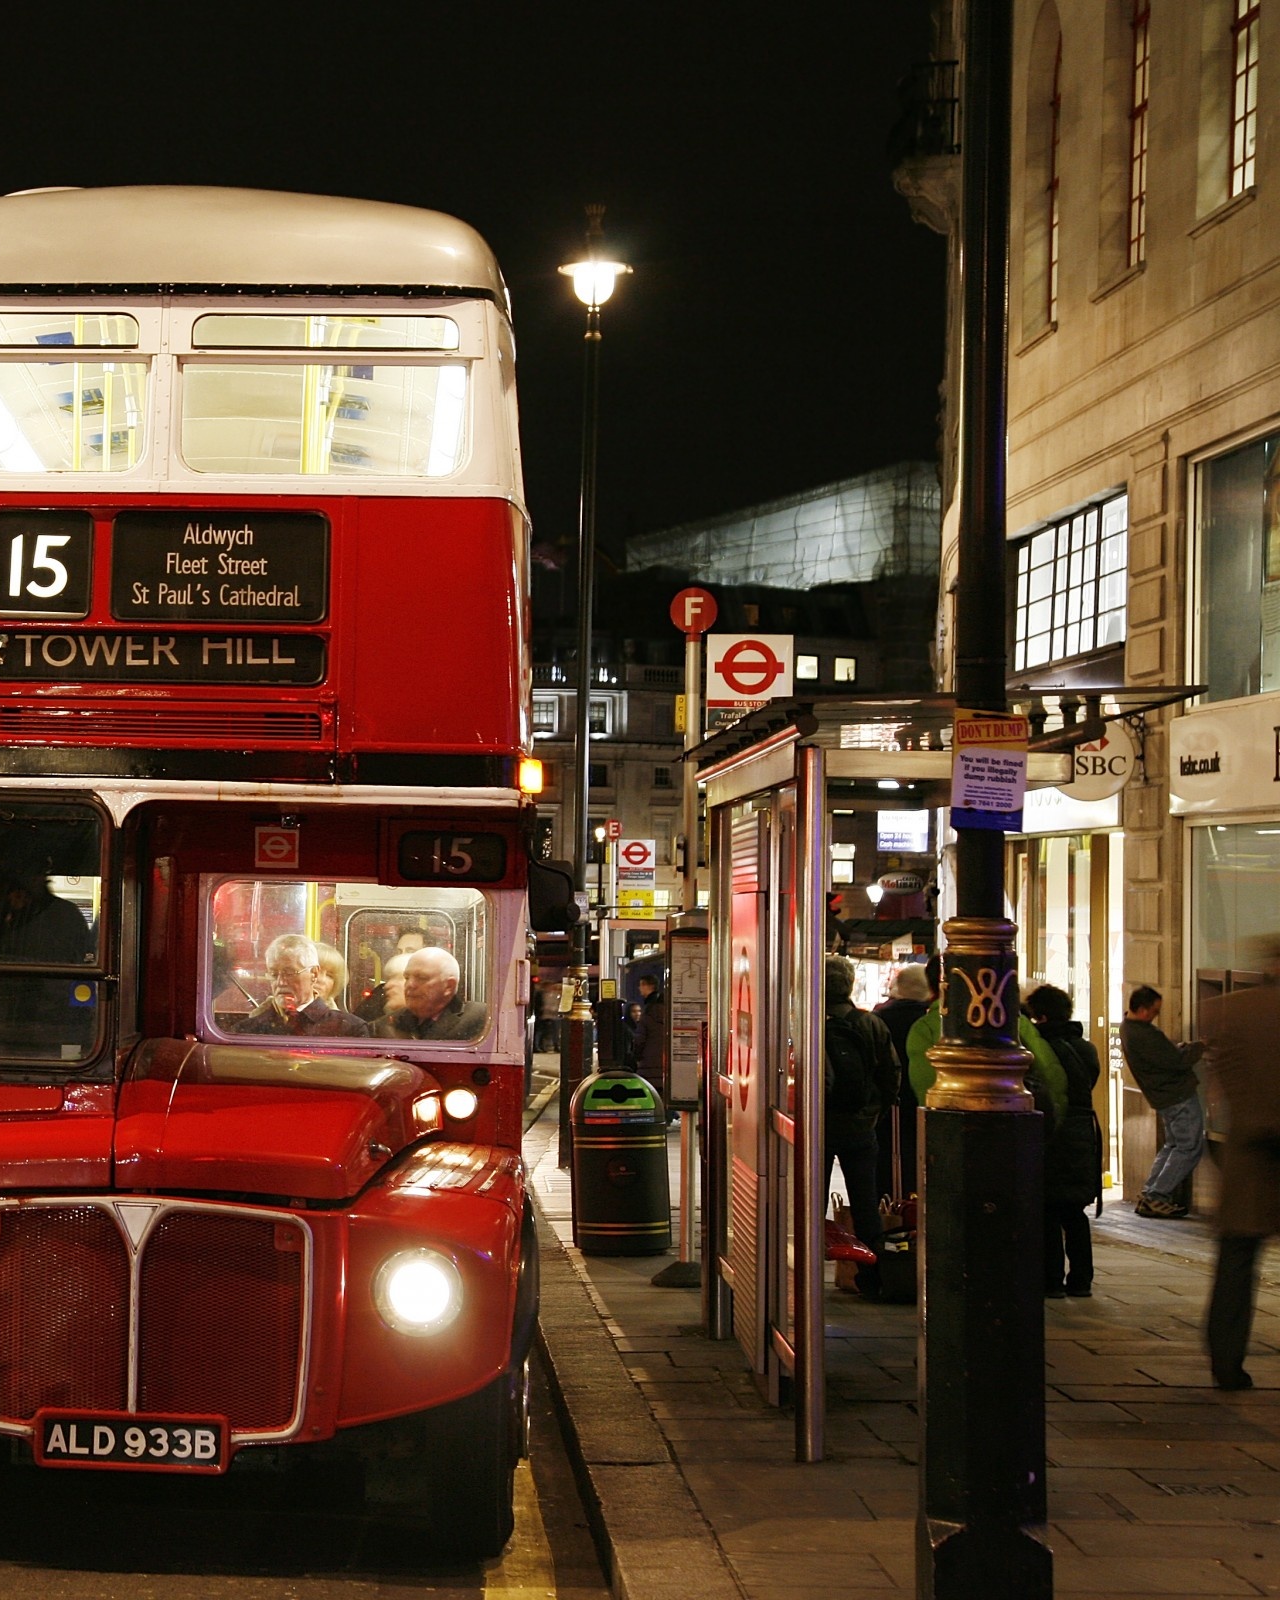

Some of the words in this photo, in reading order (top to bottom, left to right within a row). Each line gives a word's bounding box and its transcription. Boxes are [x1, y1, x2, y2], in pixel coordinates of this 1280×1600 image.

[183, 523, 253, 551] Aldwych
[9, 534, 71, 598] 15
[166, 553, 208, 574] Fleet
[218, 553, 268, 575] Street
[132, 583, 149, 604] St
[158, 584, 210, 605] Paul's
[220, 584, 301, 607] Cathedral
[684, 596, 704, 627] F
[15, 635, 180, 667] TOWER
[202, 636, 295, 665] HILL
[960, 723, 991, 739] DON'T
[993, 722, 1024, 738] DUMP
[960, 754, 974, 763] You
[991, 758, 1001, 766] be
[1003, 759, 1024, 768] fined
[987, 766, 1018, 776] illegally
[1075, 755, 1127, 776] SBC
[963, 773, 986, 782] dump
[987, 775, 1017, 784] rubbish
[609, 822, 619, 836] E
[431, 837, 473, 874] 15
[46, 1424, 116, 1455] ALD
[124, 1427, 216, 1459] 933B
